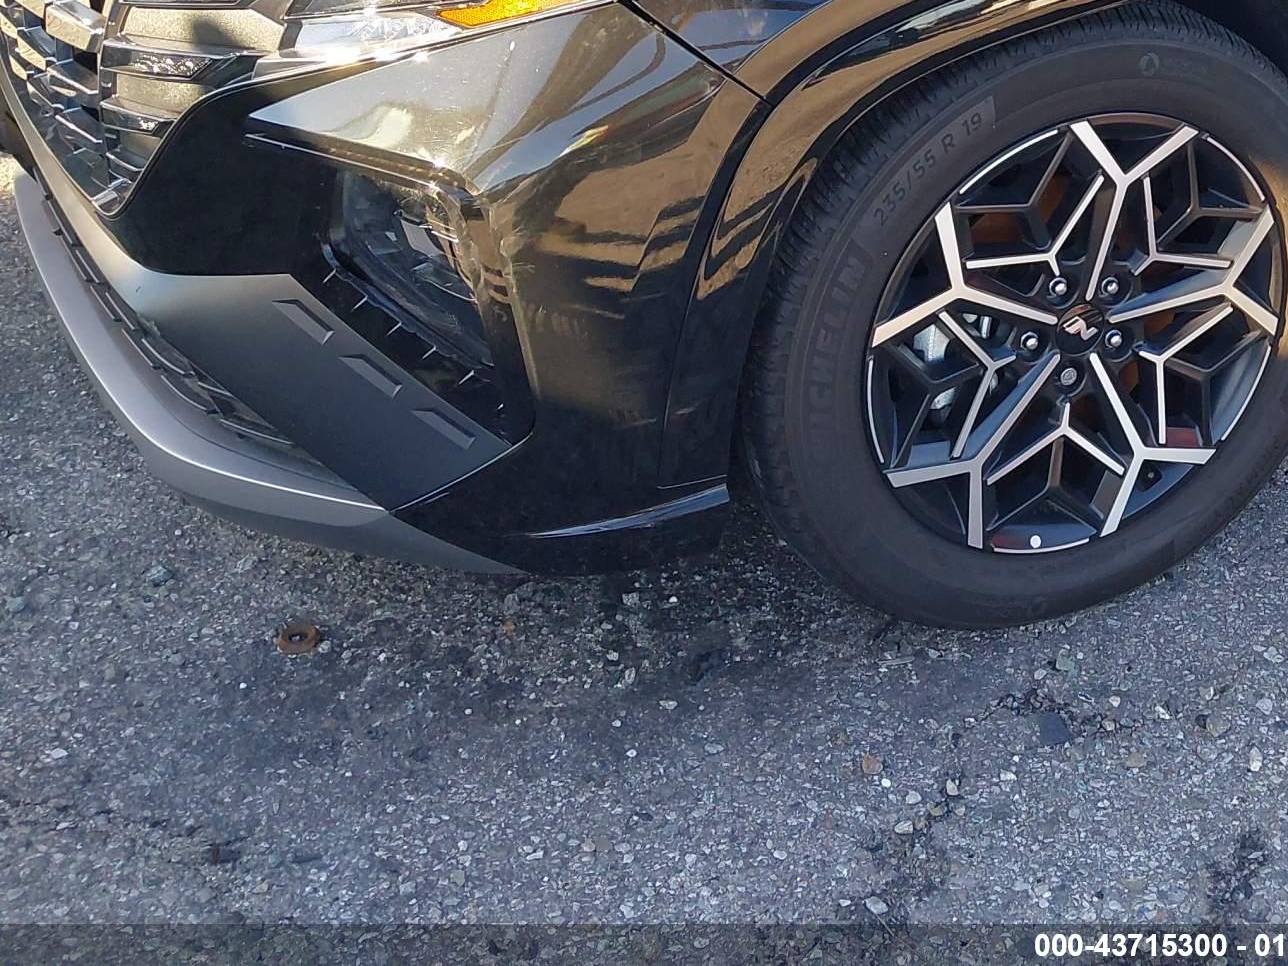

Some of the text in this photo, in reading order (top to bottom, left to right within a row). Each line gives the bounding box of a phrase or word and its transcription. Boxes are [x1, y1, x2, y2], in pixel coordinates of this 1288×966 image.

[873, 112, 983, 227] 235/55 R 19
